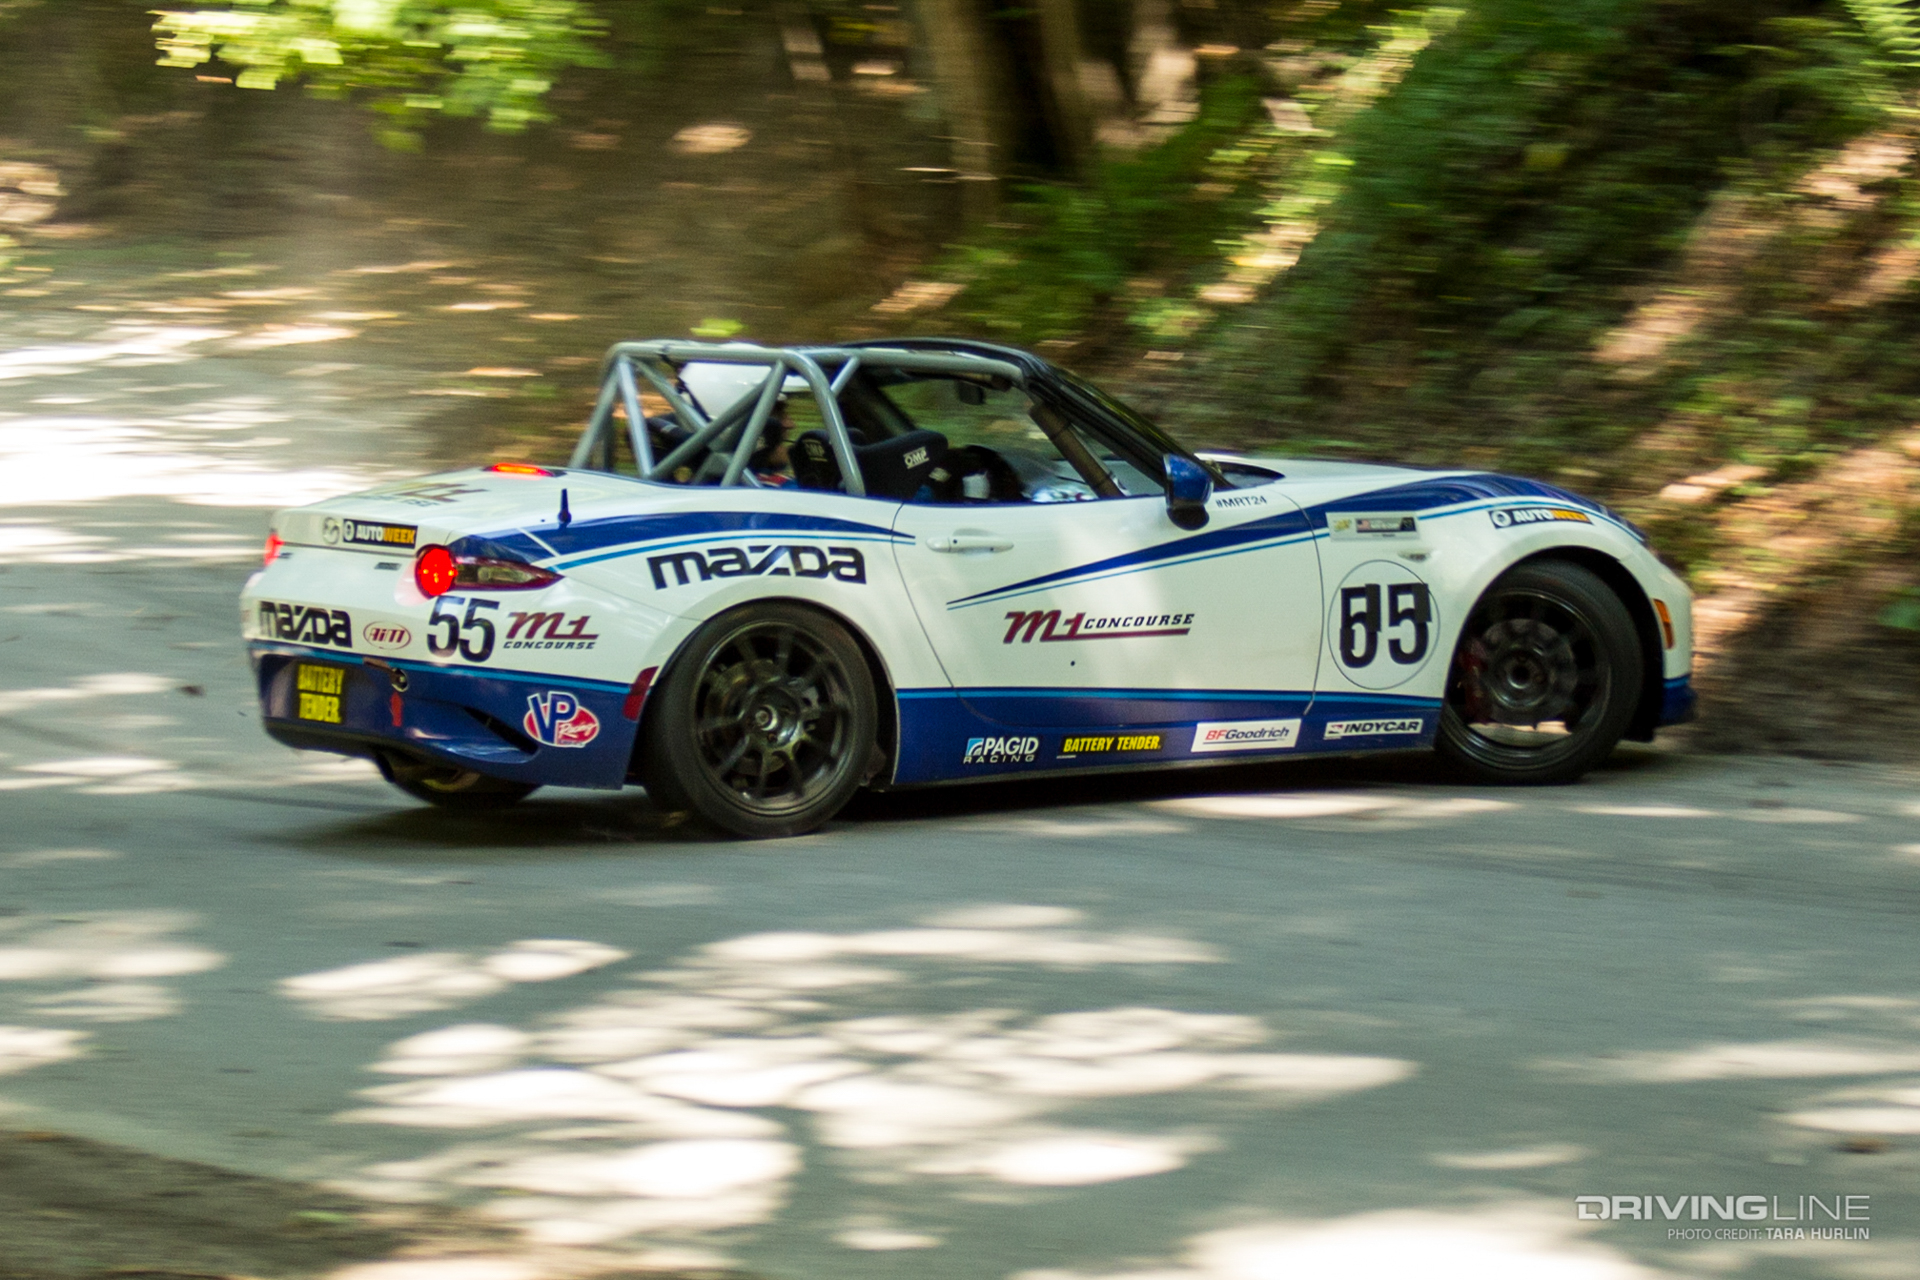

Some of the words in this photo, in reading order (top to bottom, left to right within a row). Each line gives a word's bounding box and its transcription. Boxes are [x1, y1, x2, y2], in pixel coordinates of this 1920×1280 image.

[904, 449, 929, 468] OMP
[1215, 495, 1267, 508] #MRT24
[355, 524, 415, 544] AUTOWEEK
[427, 595, 500, 663] 55
[506, 612, 600, 640] M1
[1003, 610, 1086, 644] M1
[1084, 613, 1195, 630] CONCOURSE
[503, 641, 596, 650] CONCOURSE
[299, 693, 342, 723] TEER
[527, 689, 578, 745] VP
[1205, 726, 1290, 741] BFGoodrich
[1343, 721, 1420, 733] INDYCAR
[983, 737, 1040, 756] PAGID
[1062, 736, 1115, 753] BATTERY
[1117, 735, 1160, 750] TENDER
[963, 754, 1036, 764] RACING
